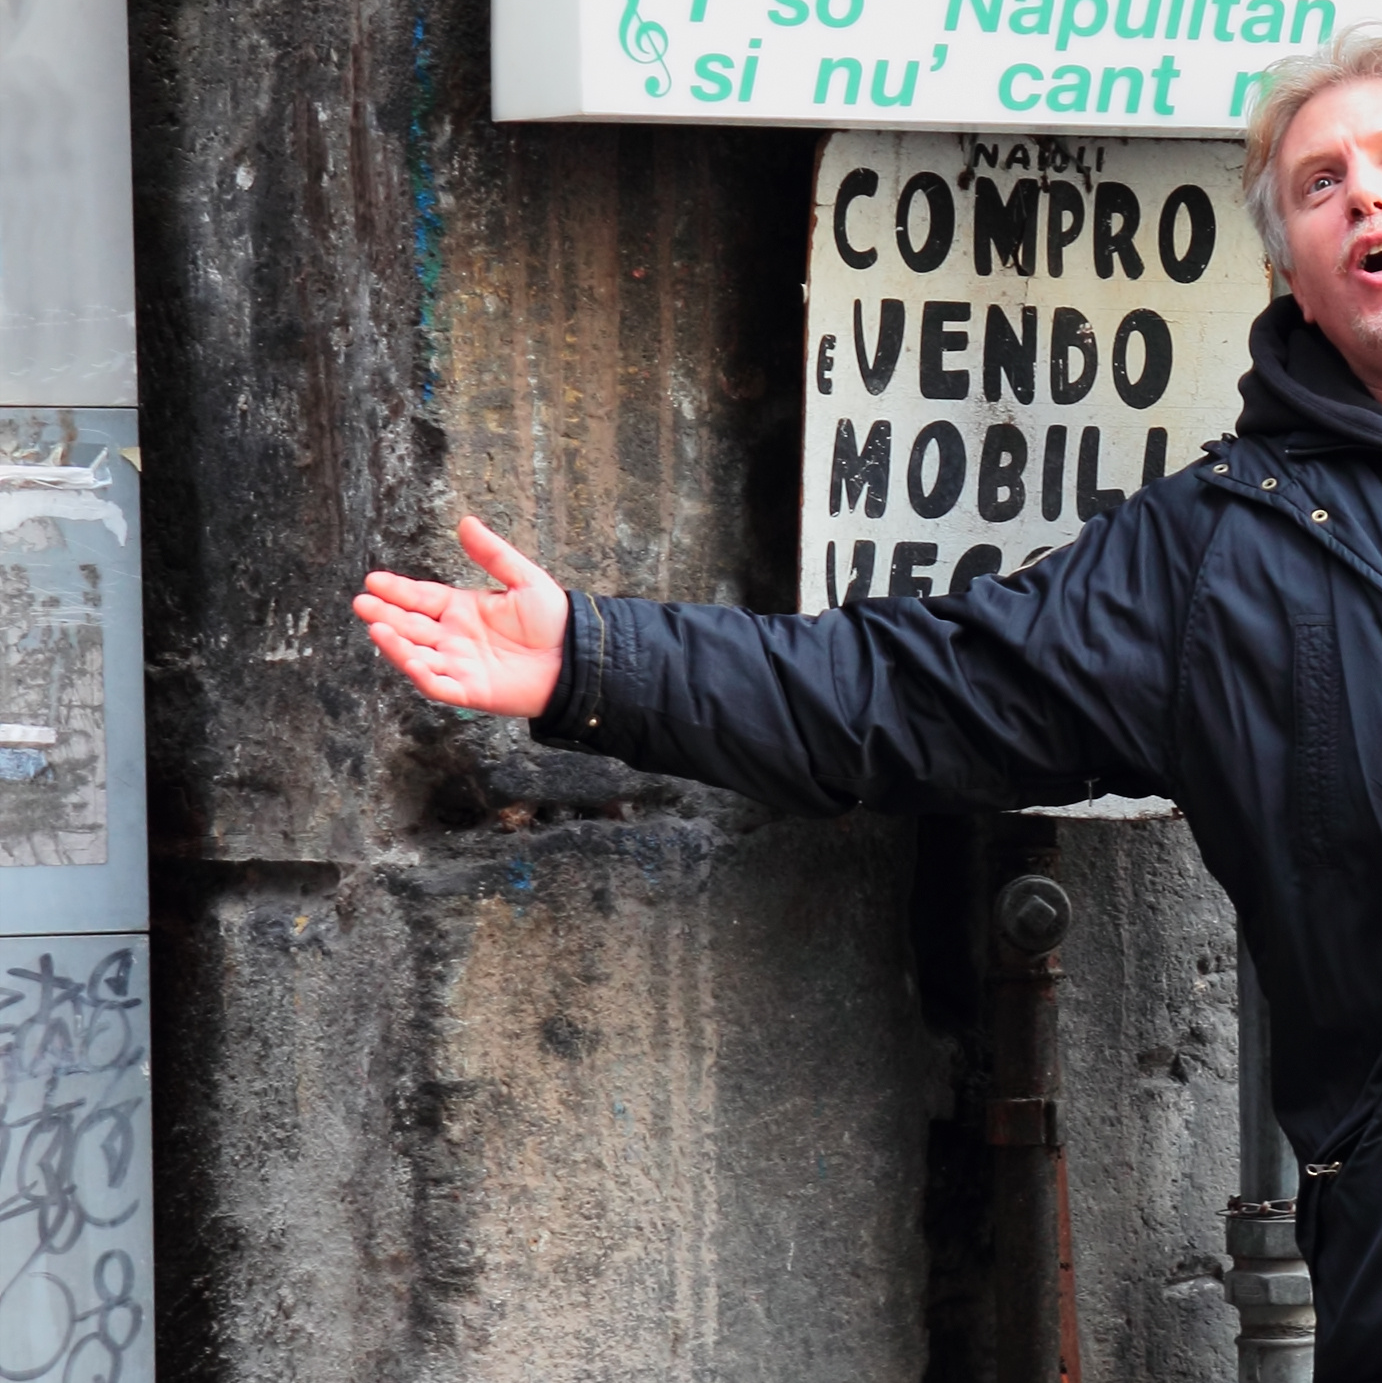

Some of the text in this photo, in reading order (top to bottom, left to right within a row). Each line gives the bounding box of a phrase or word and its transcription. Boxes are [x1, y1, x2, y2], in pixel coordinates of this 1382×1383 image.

[690, 38, 762, 102] si
[813, 44, 948, 107] nu'
[998, 55, 1181, 116] cant
[833, 166, 1217, 284] COMPRO
[816, 298, 1174, 410] E VENDO
[829, 418, 1168, 522] MOBILI
